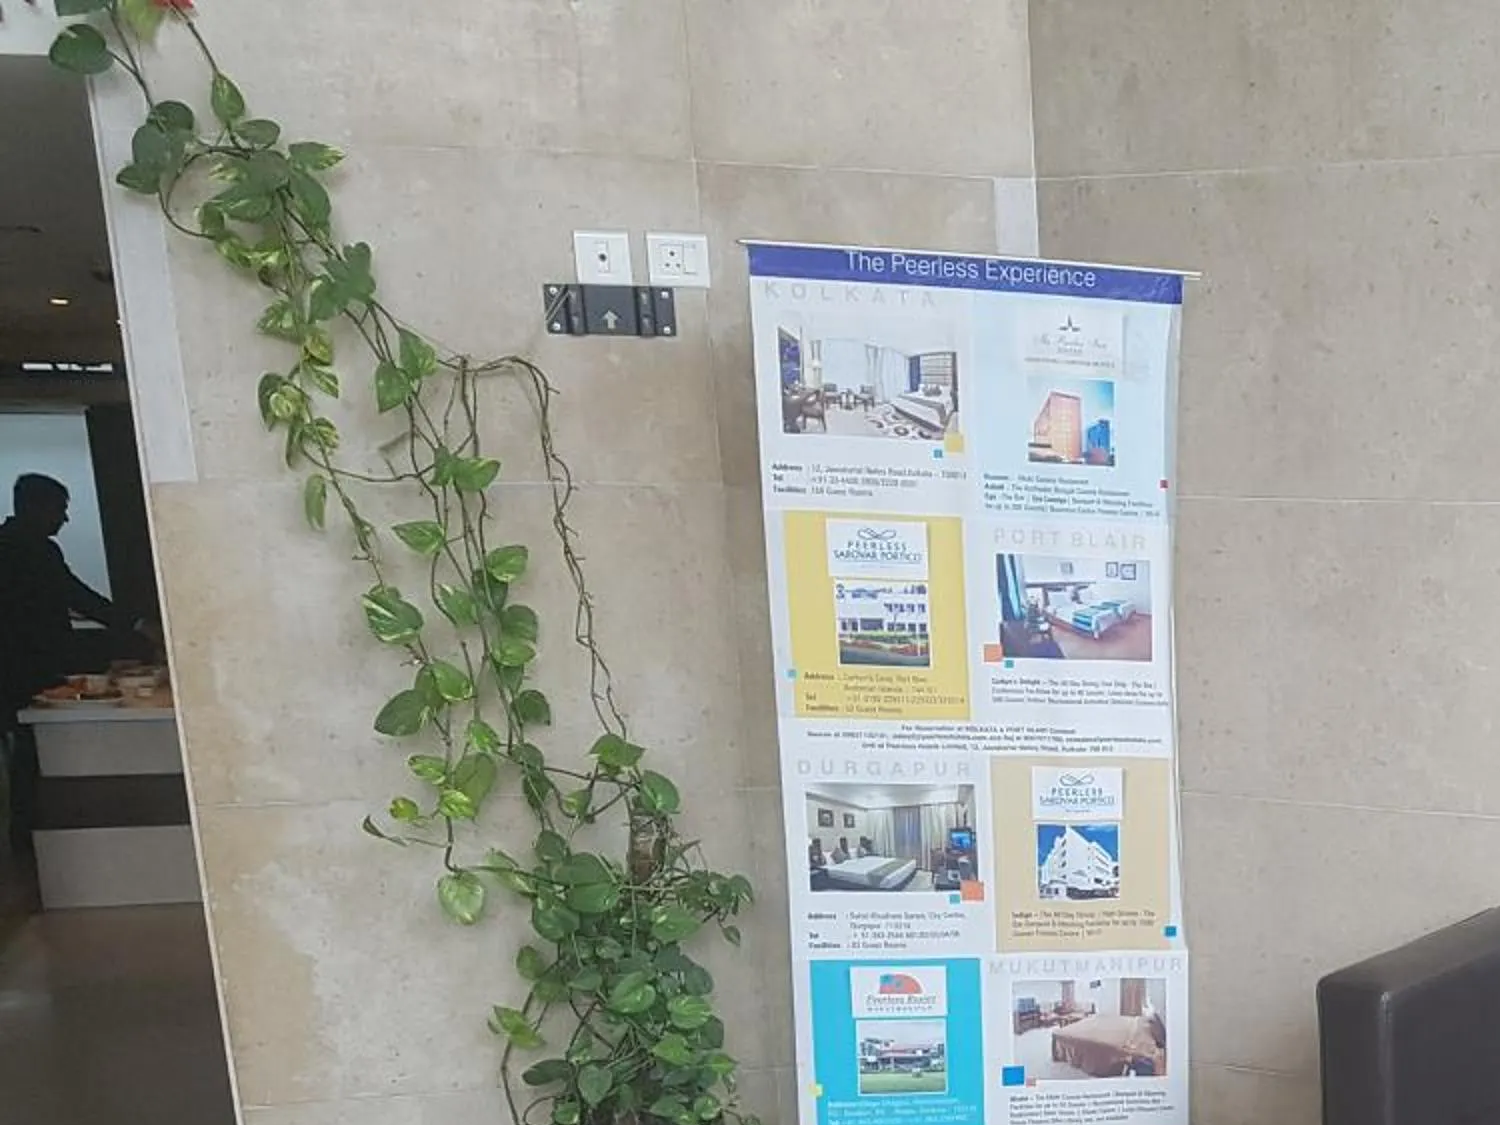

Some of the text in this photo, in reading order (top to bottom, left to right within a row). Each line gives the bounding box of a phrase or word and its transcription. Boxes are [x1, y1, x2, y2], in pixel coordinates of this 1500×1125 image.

[847, 251, 1096, 287] The Peerless Experience
[764, 282, 936, 308] KOLKATA
[994, 528, 1146, 549] PORT BLAIR
[797, 758, 972, 778] DURGAPUR
[989, 957, 1183, 976] MUKUTMANIPUR
